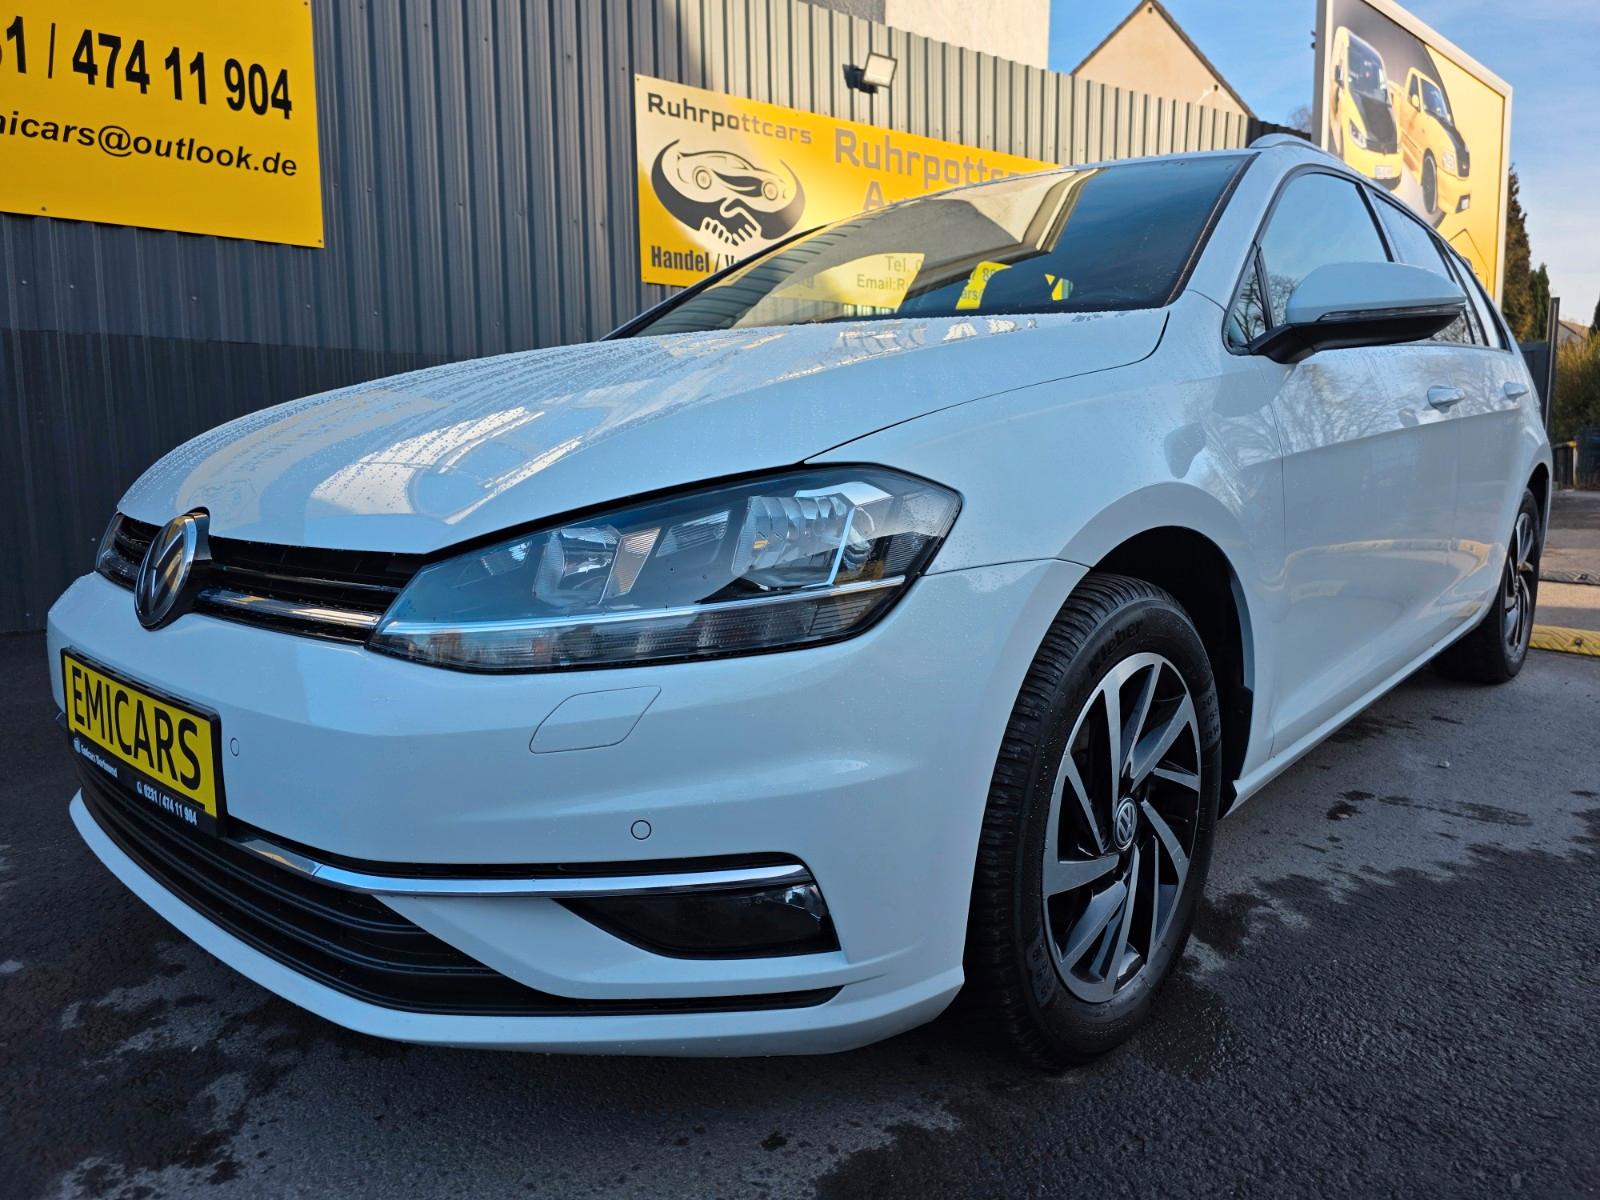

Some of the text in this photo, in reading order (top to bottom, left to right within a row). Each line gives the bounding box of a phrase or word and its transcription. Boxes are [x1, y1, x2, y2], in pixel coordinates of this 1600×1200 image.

[72, 28, 150, 95] 474
[164, 46, 207, 105] 11
[223, 57, 292, 121] 904
[647, 92, 812, 145] Ruhrpottcars
[651, 245, 710, 273] Handel
[72, 665, 201, 790] EMICARS
